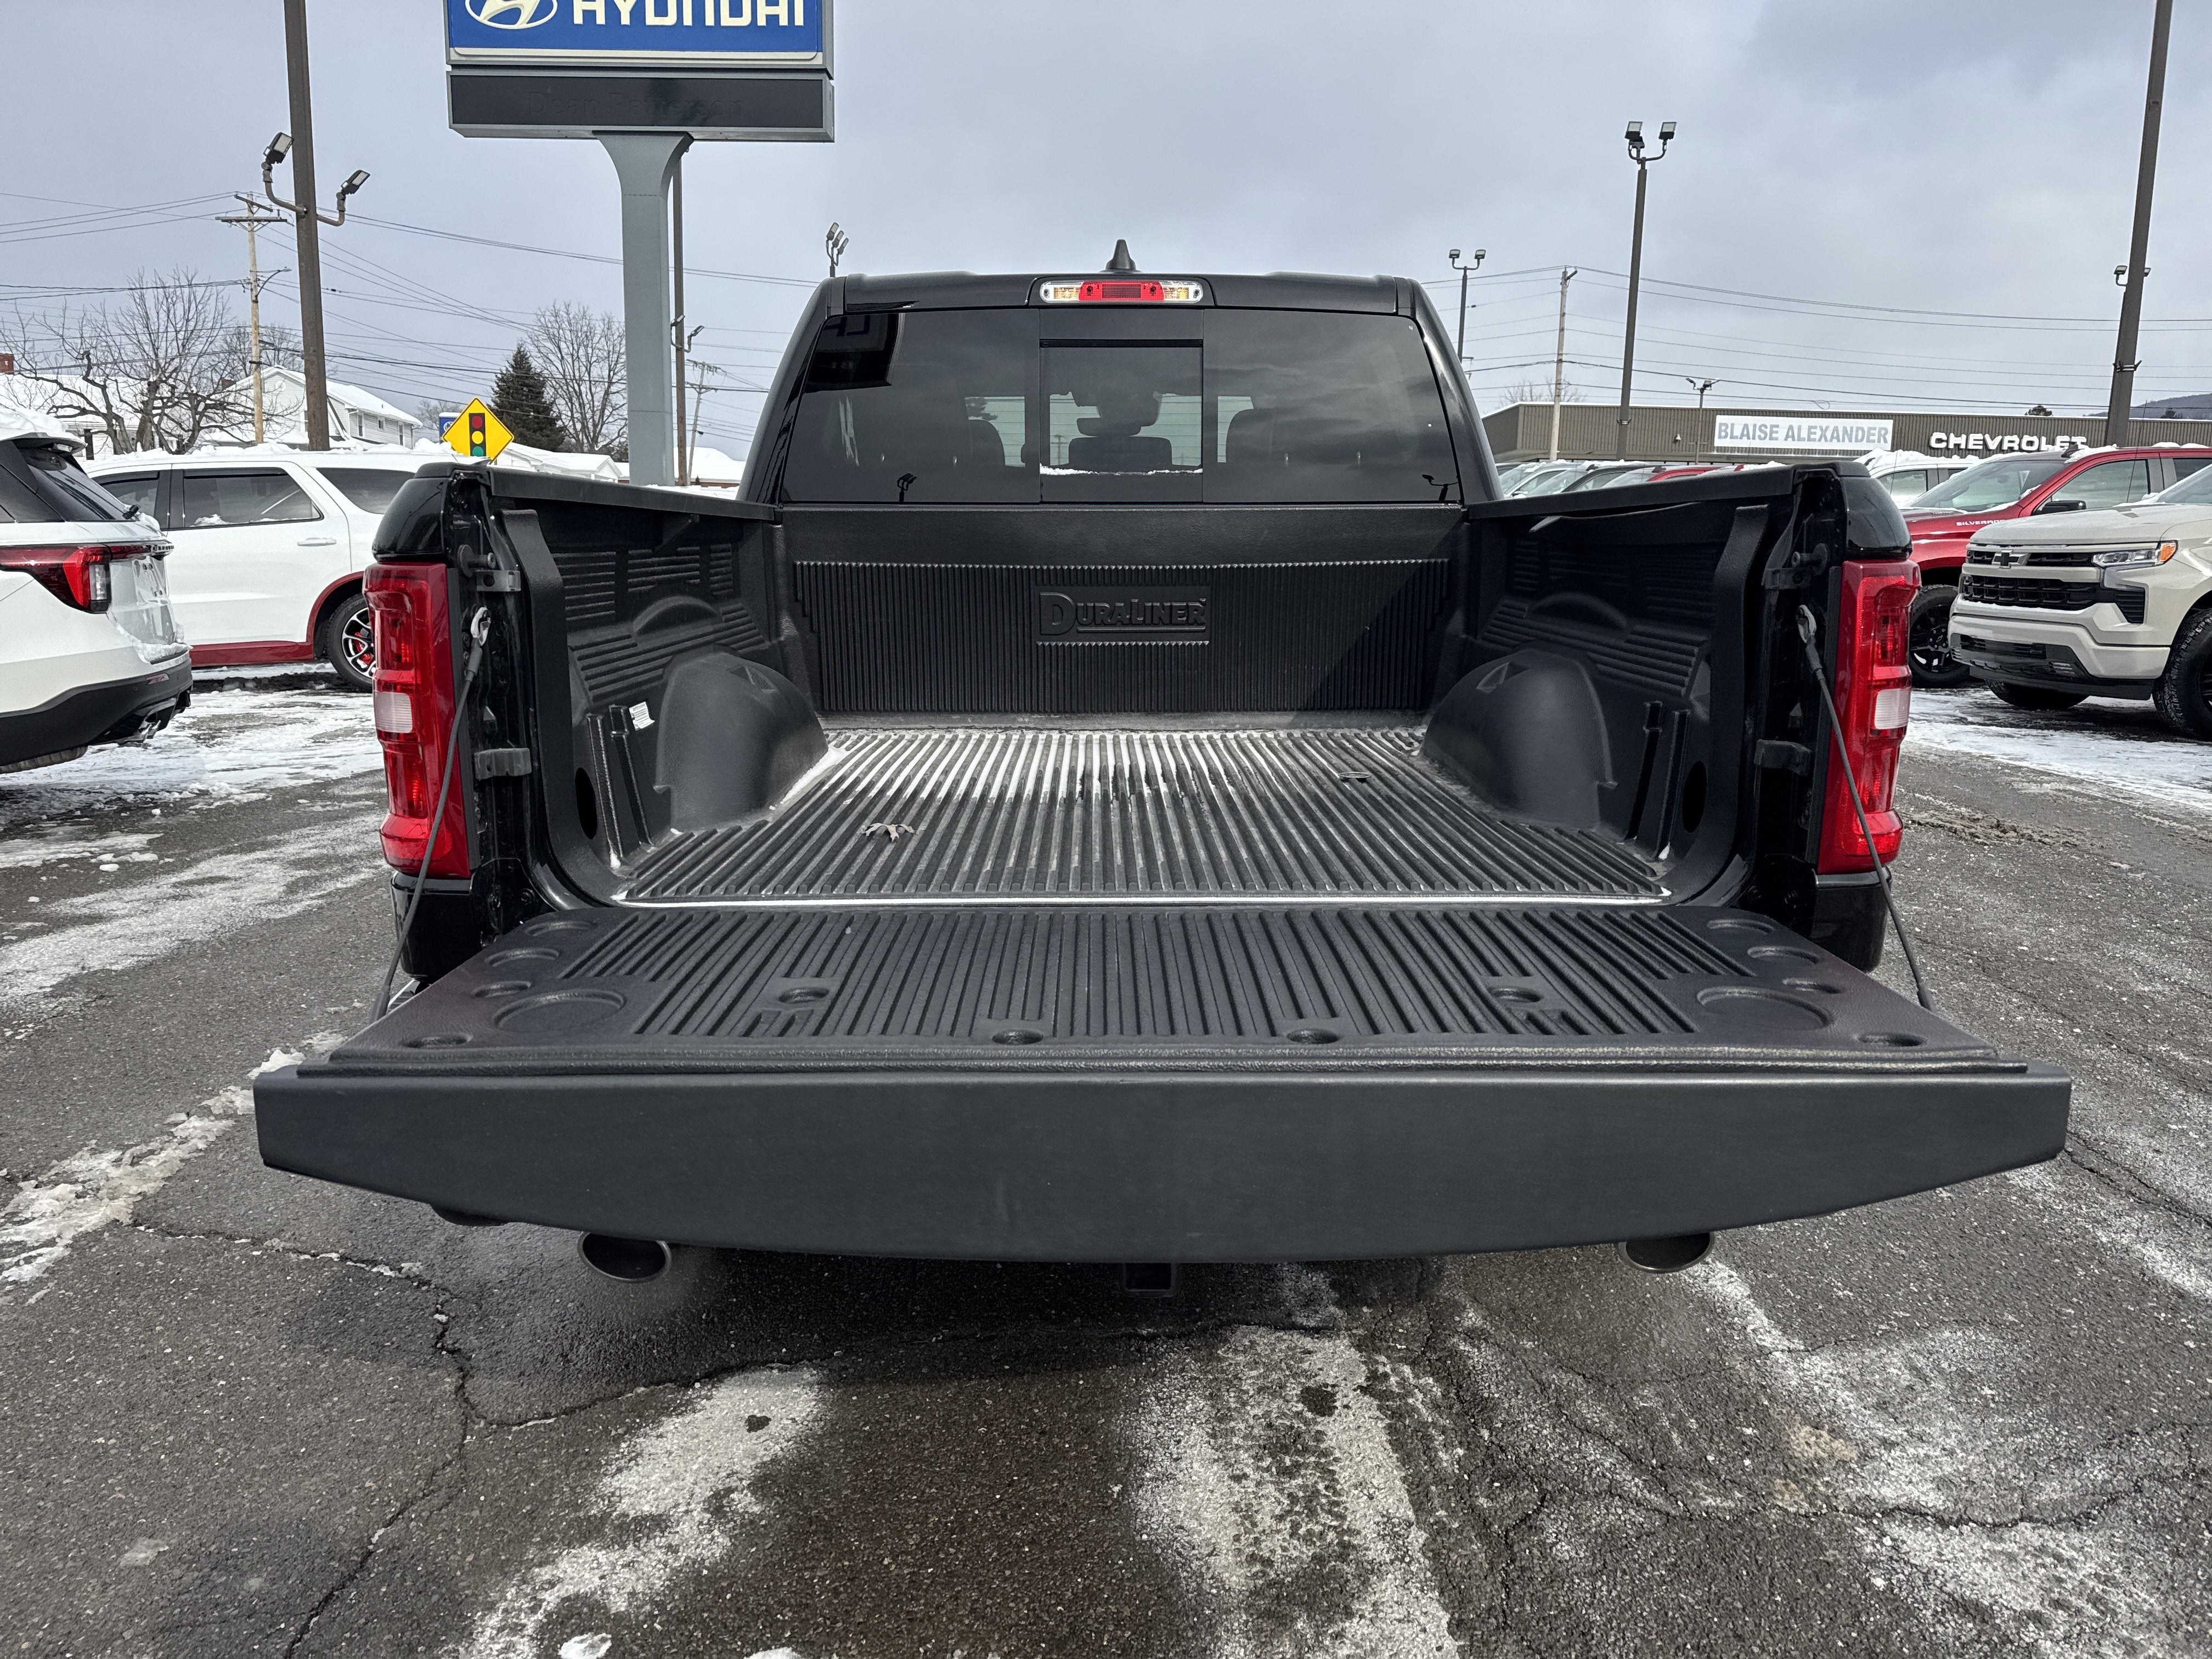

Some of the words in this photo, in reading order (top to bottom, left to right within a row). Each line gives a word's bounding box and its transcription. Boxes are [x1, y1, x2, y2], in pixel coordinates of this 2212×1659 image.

[573, 0, 804, 26] HYUNDAI
[1717, 422, 1780, 441] BLAISE
[1784, 424, 1889, 444] ALEXANDER
